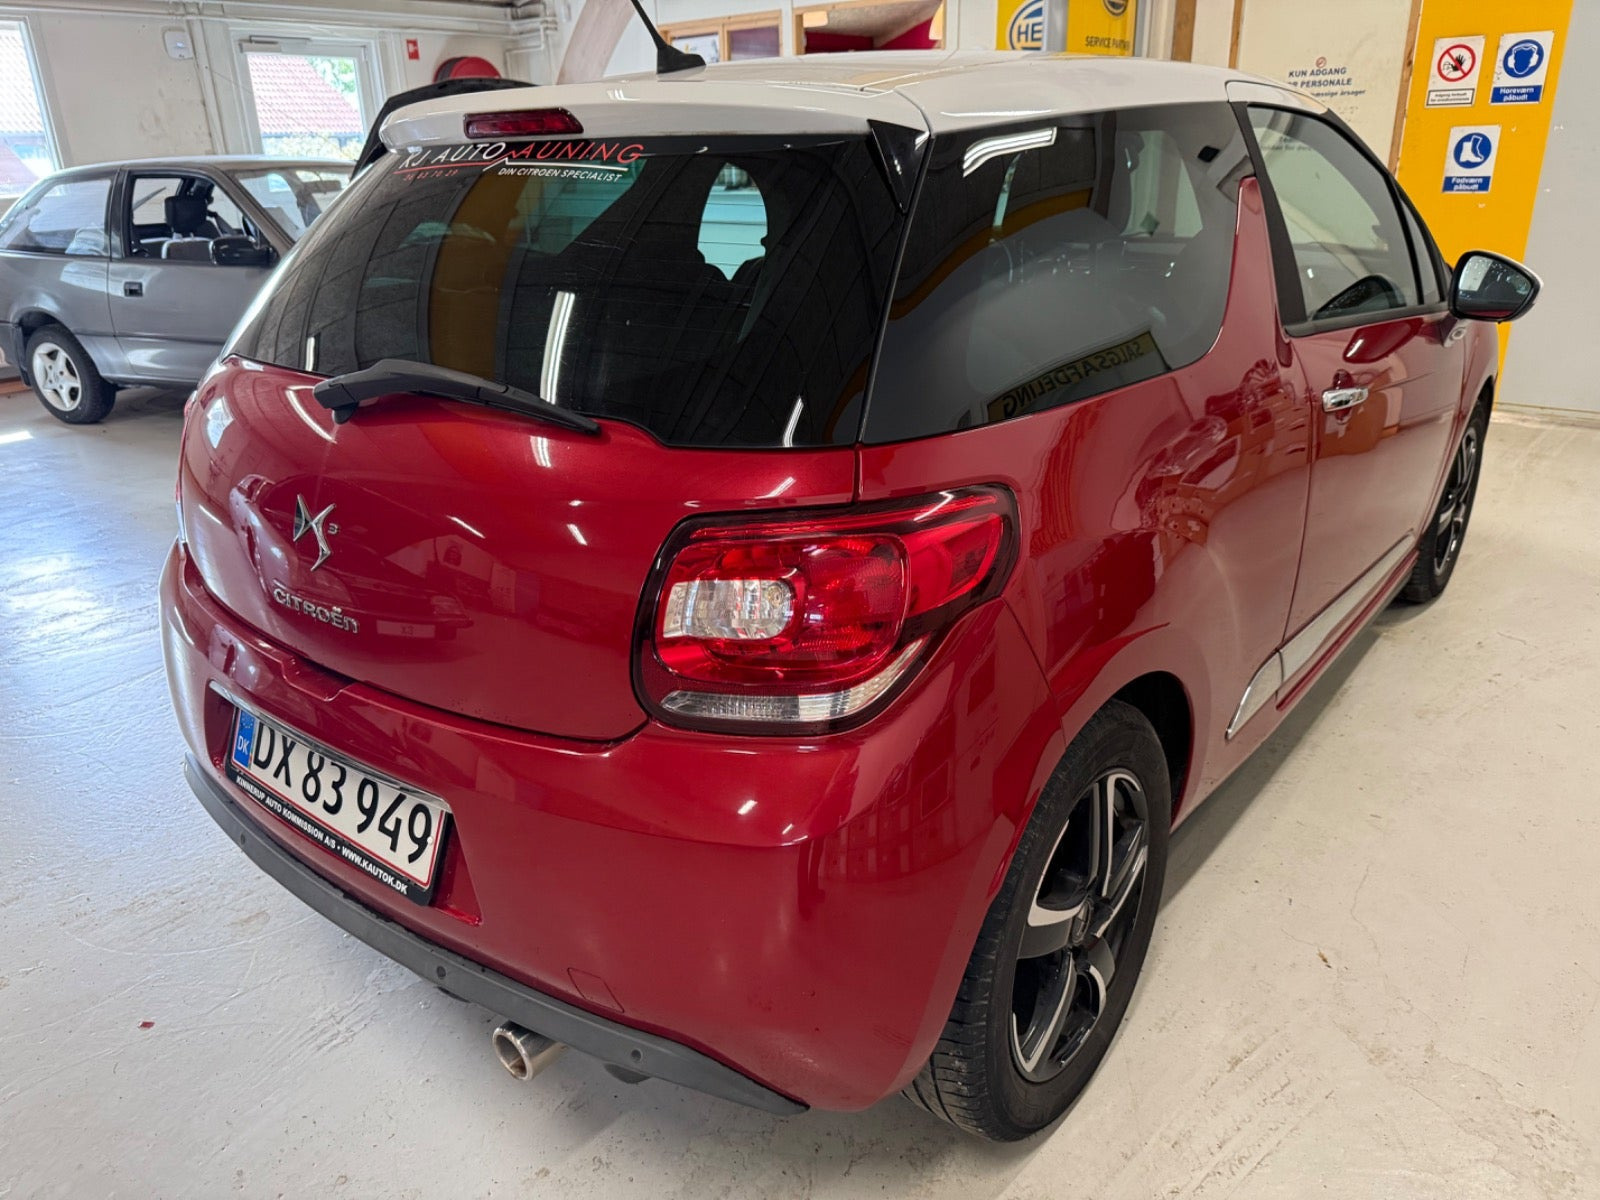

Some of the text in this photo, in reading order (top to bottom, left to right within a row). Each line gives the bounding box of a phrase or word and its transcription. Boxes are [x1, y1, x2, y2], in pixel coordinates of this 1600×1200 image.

[1085, 35, 1111, 48] SERVICE
[1288, 67, 1347, 78] KUN ADGANG
[1300, 78, 1352, 88] PERSONALE
[431, 142, 506, 164] AUTO
[513, 141, 645, 164] AUNING
[498, 167, 622, 183] DIN CITROEN SPECIALIST
[237, 722, 433, 865] DK DX 83 949
[236, 775, 408, 895] KINNERUP AUTO KOMMISSION A/S WWW.KAUTOK.DK
